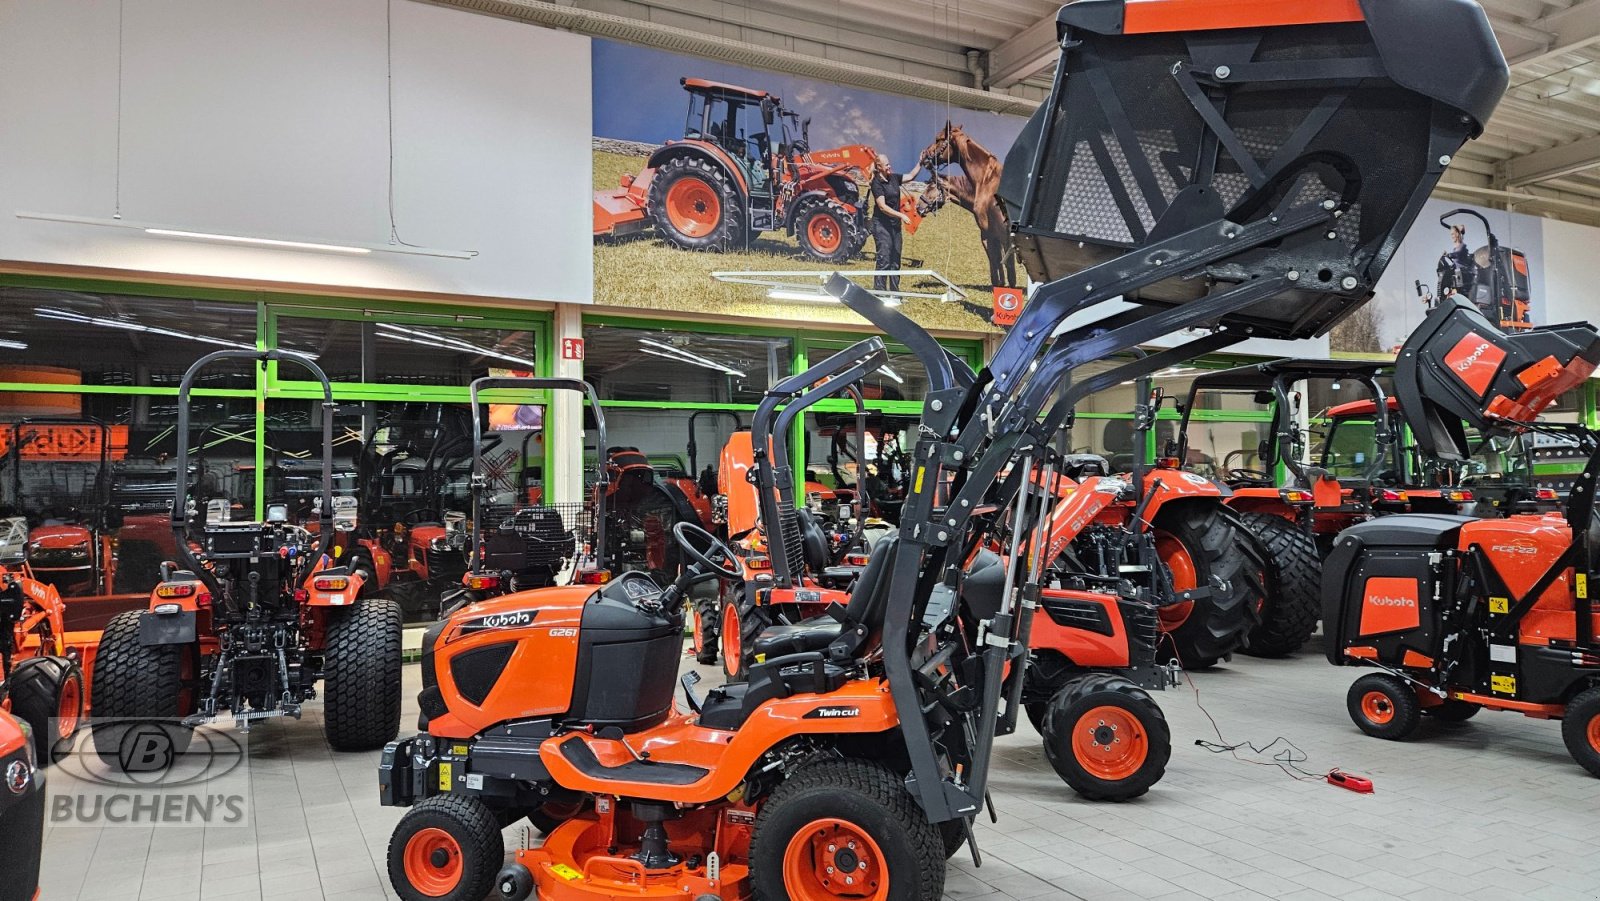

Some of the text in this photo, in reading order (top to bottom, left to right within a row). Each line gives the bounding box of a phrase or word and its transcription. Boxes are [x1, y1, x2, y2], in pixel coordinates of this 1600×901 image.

[1457, 343, 1489, 372] Kubota
[1369, 595, 1415, 607] Kubota
[483, 612, 530, 627] Kubota
[549, 628, 578, 637] G261
[818, 708, 860, 717] Twin cut
